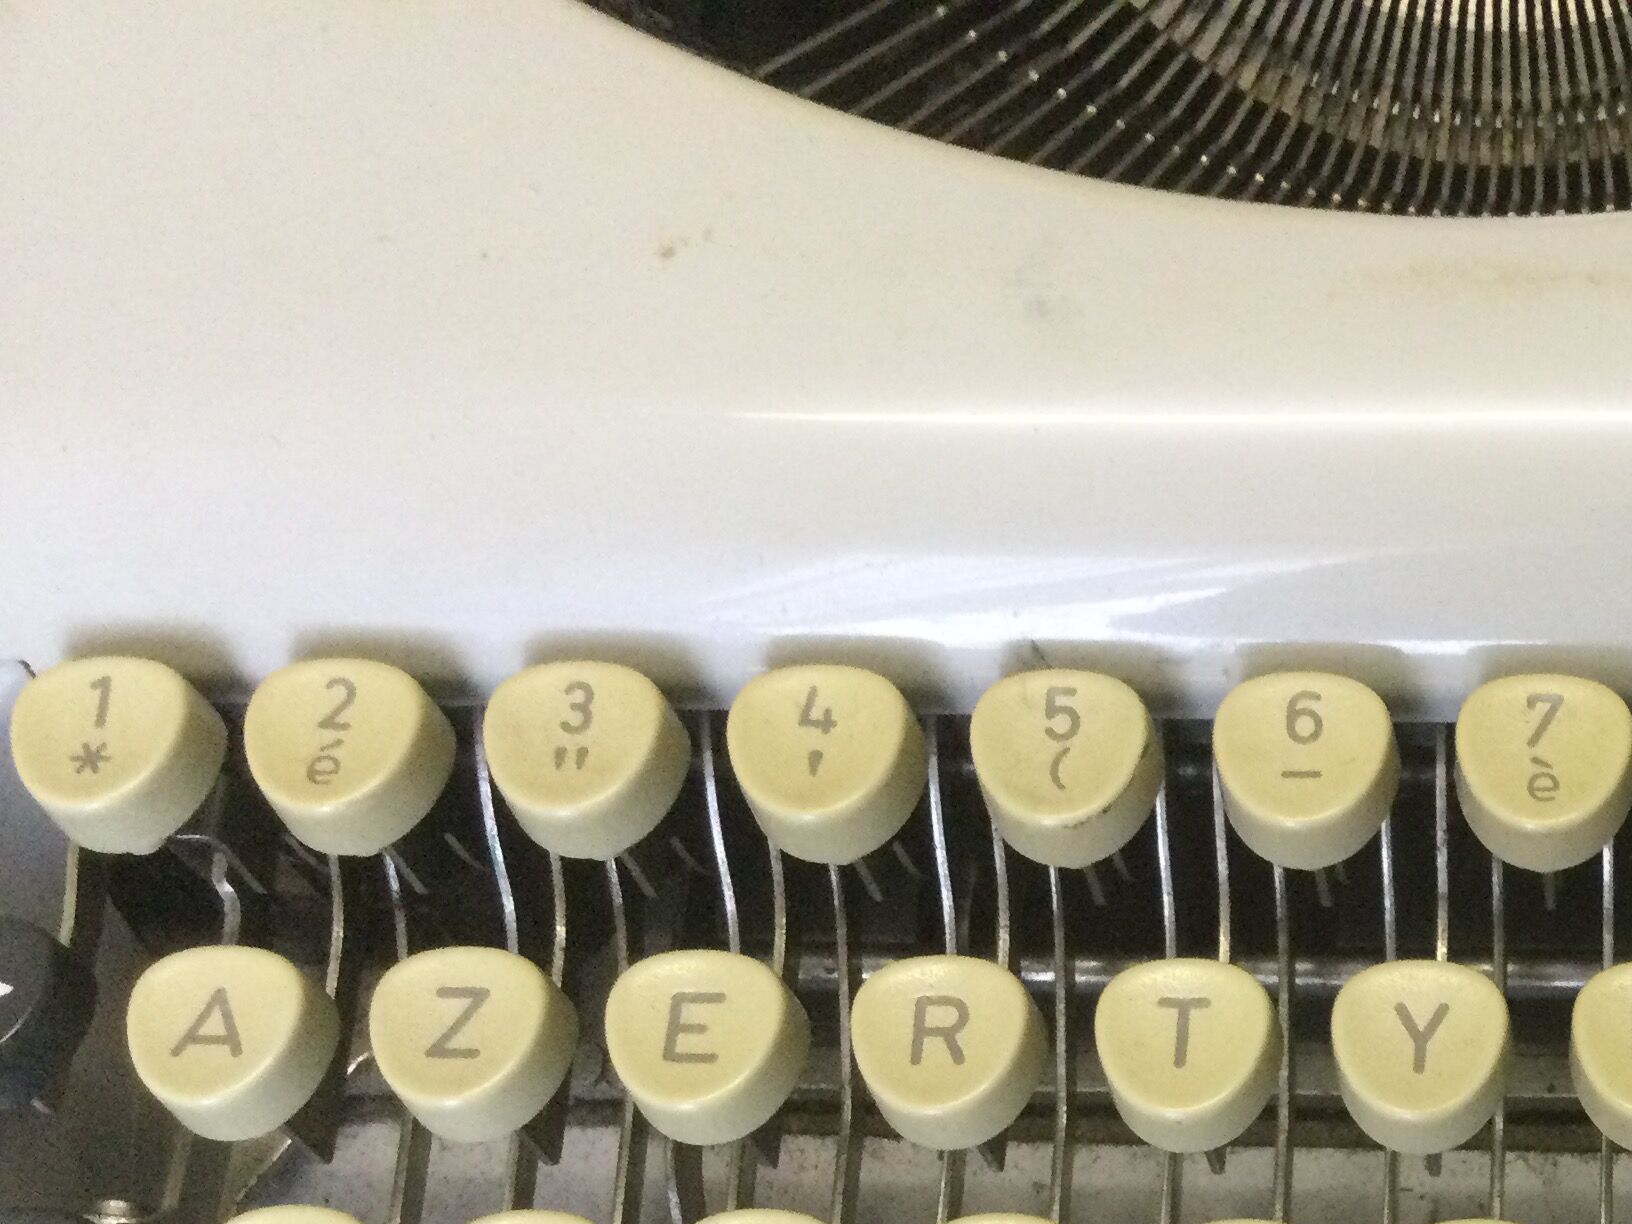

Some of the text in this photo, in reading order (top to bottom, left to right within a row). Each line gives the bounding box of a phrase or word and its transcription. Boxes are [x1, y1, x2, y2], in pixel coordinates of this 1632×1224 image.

[90, 676, 111, 728] 1
[318, 678, 356, 731] 2
[560, 682, 594, 734] 3
[798, 686, 837, 735] 4
[1045, 687, 1080, 742] 5
[1286, 691, 1323, 745] 6
[1527, 694, 1564, 748] 7
[307, 739, 344, 785] é
[1050, 747, 1070, 790] (
[1527, 756, 1559, 802] è
[170, 988, 243, 1058] A
[425, 986, 490, 1059] Z
[662, 992, 726, 1064] E
[910, 996, 970, 1065] R
[1157, 997, 1211, 1068] T
[1394, 1002, 1449, 1074] Y
